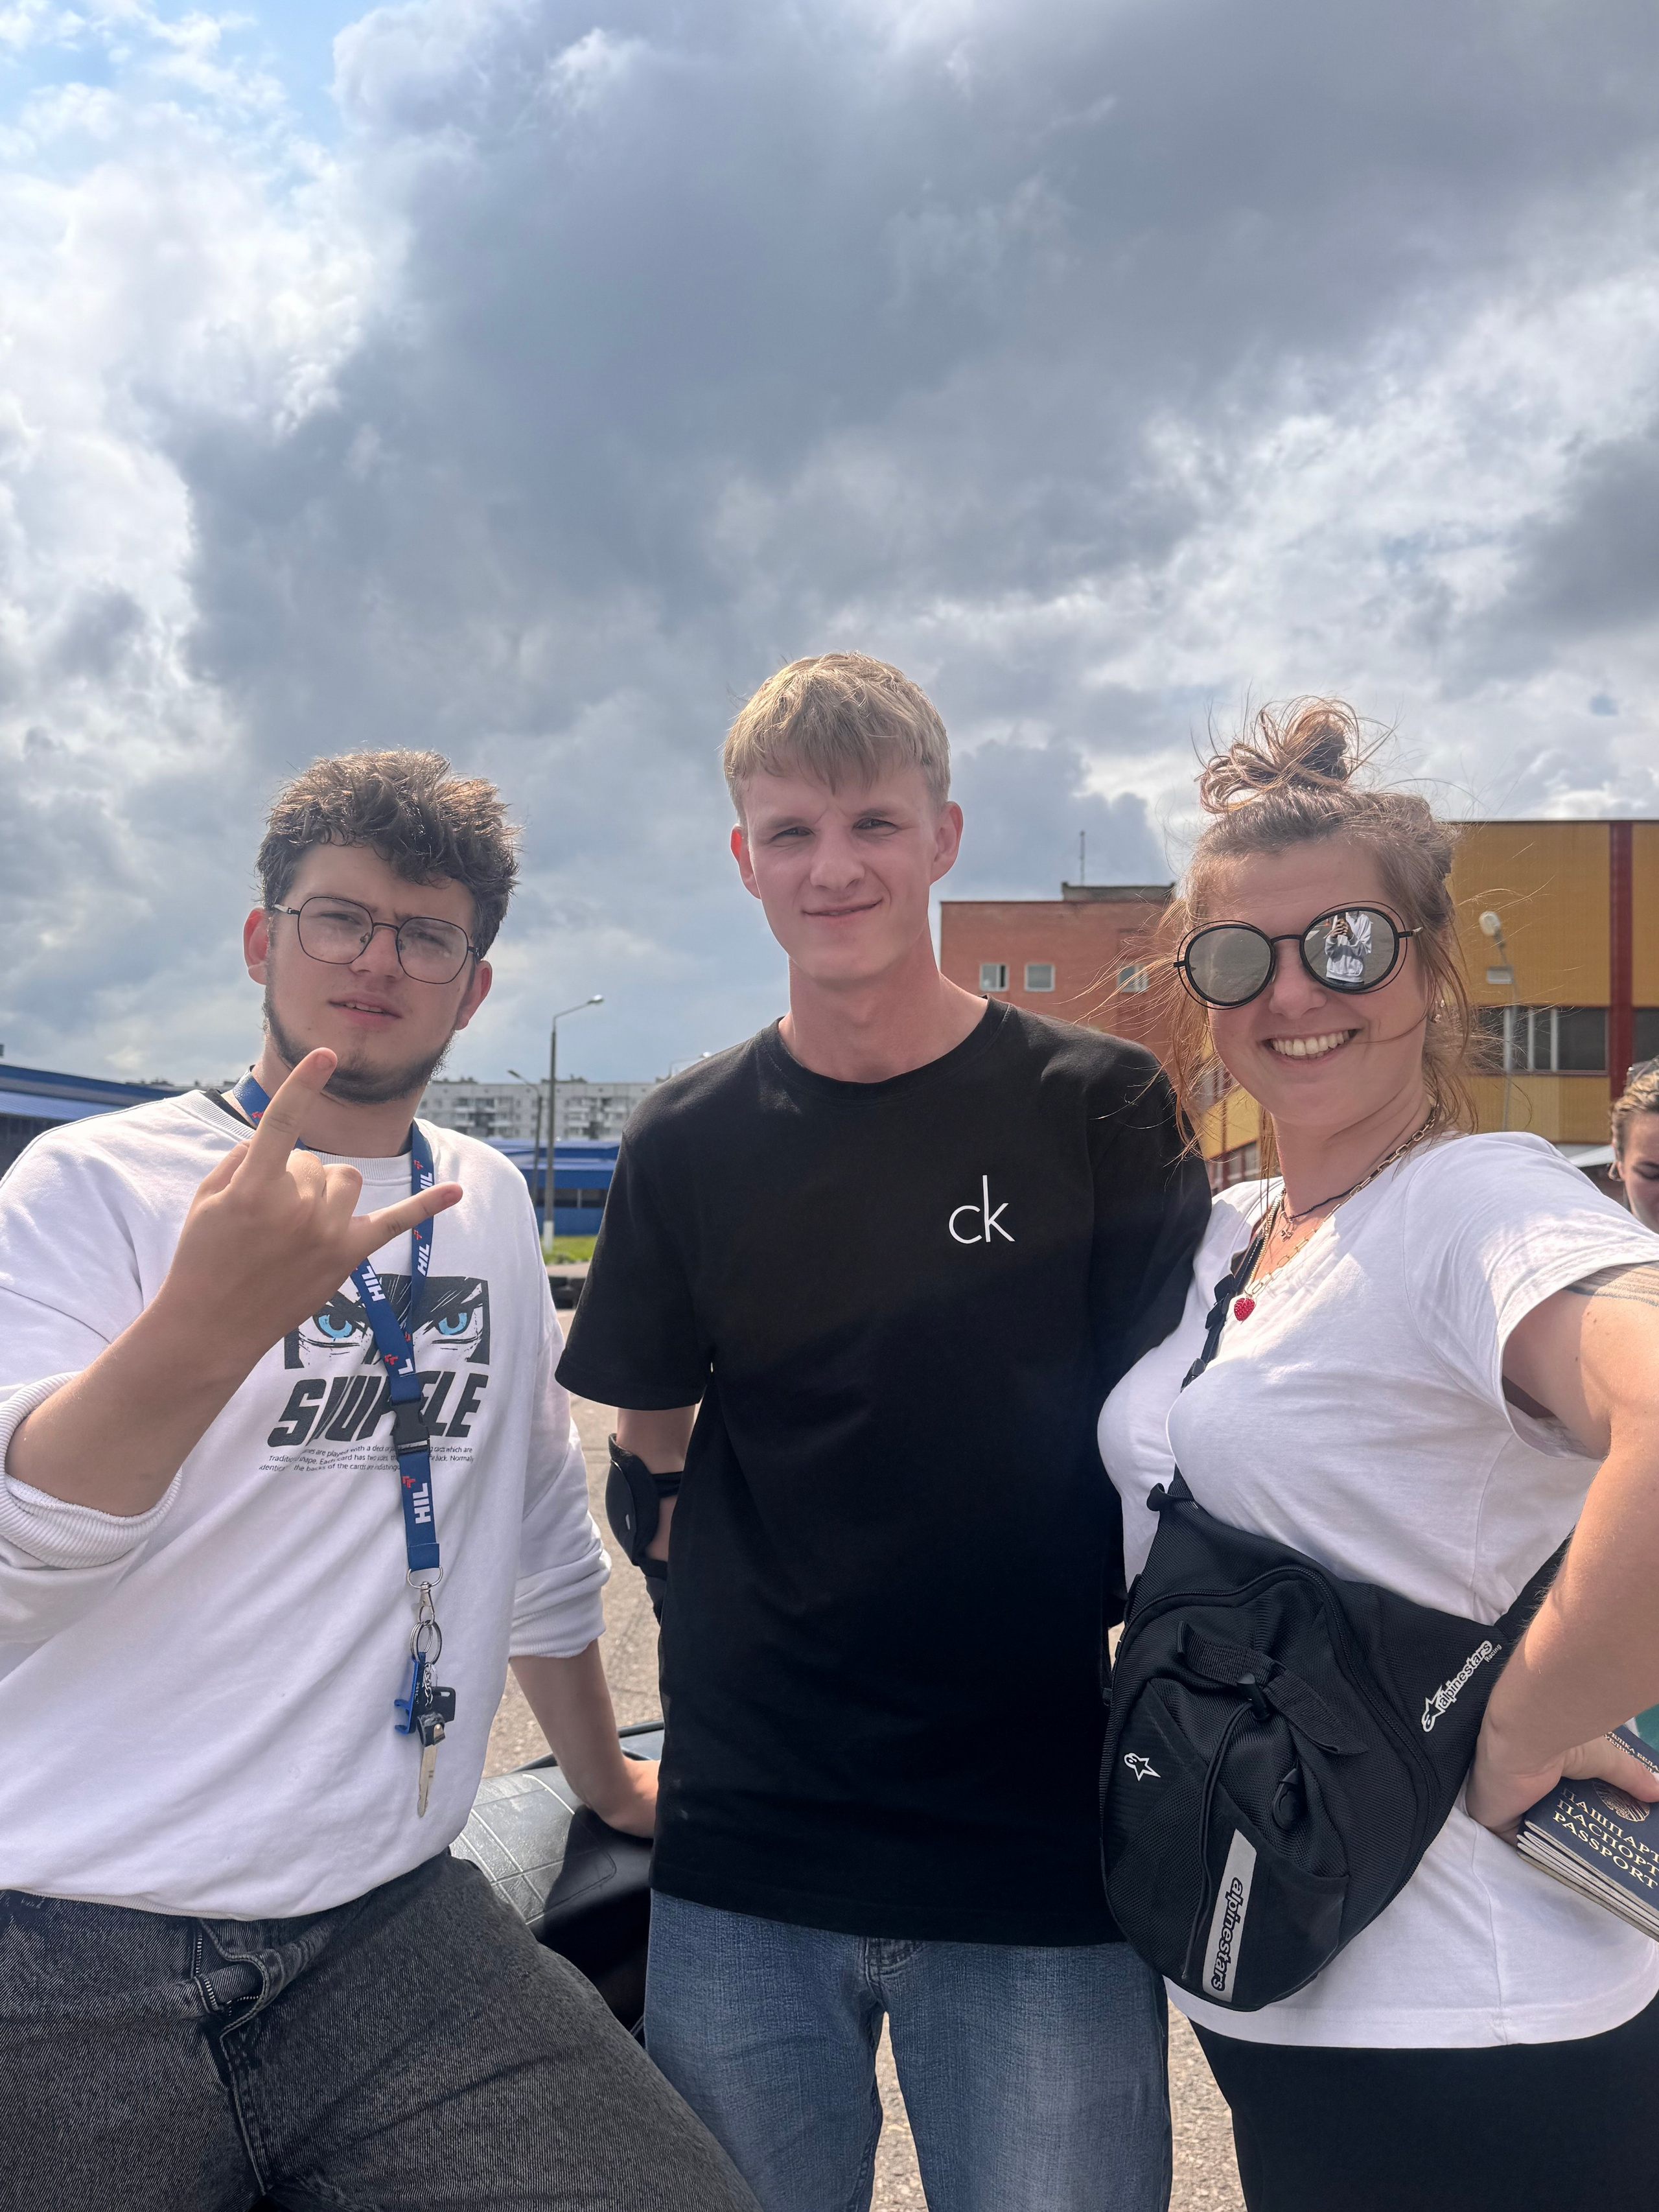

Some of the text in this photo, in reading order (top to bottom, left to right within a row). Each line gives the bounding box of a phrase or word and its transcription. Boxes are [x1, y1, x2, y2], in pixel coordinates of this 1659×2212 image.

[420, 1172, 433, 1189] IL
[949, 1175, 1015, 1244] ck
[362, 1266, 386, 1301] HIL
[417, 1243, 430, 1276] HIL
[413, 1482, 432, 1524] HIL
[1437, 1640, 1493, 1710] alpinestars
[1483, 1644, 1502, 1662] Racing
[1553, 1811, 1658, 1889] PASSPORT
[1557, 1799, 1659, 1876] ПАСПОРТ
[1211, 1877, 1244, 1992] alpinestars
